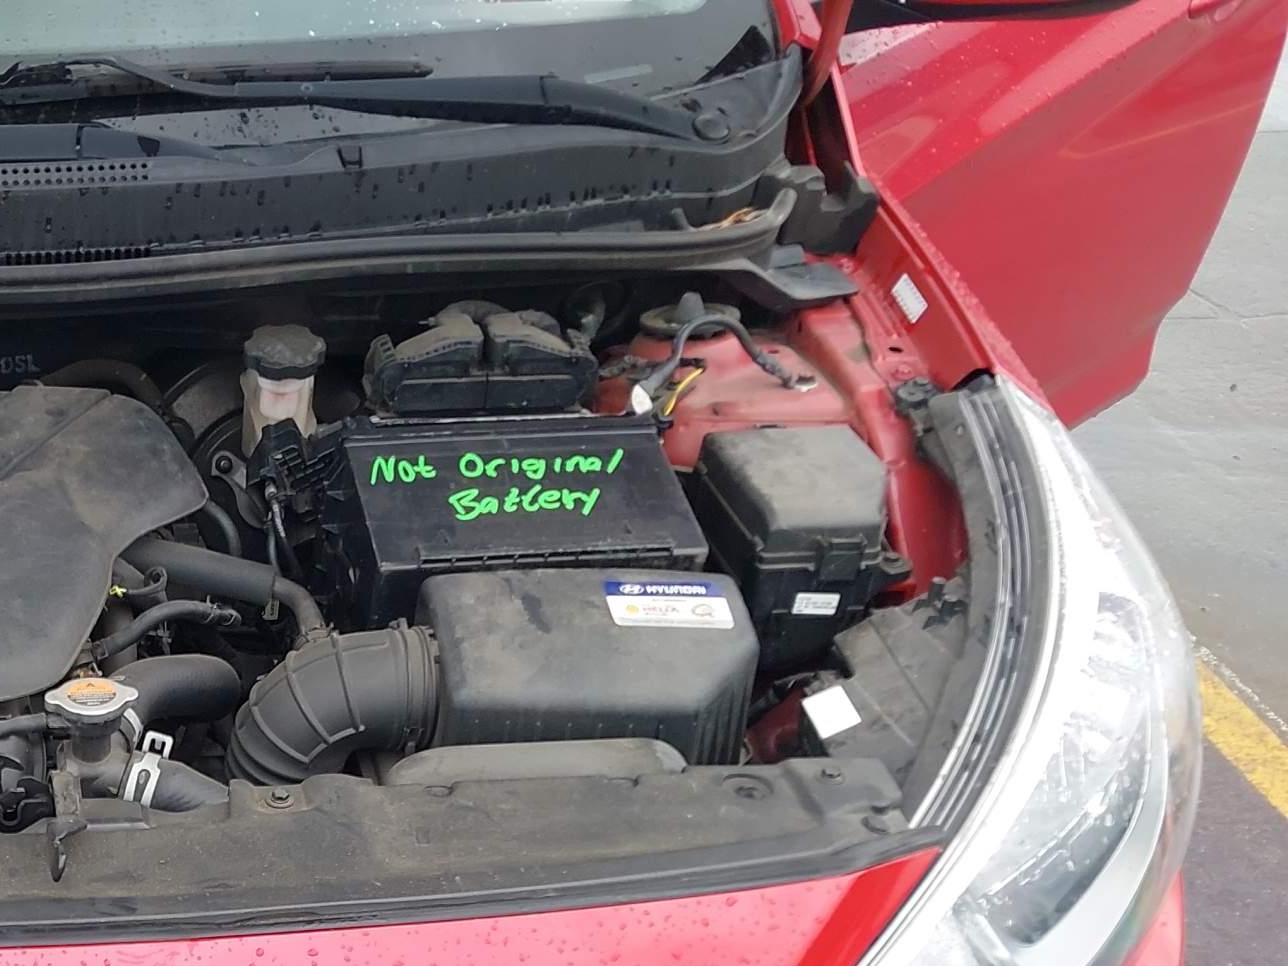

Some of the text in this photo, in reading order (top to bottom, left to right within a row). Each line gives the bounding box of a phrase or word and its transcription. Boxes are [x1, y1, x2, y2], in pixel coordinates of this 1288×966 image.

[369, 447, 625, 486] Not Original
[448, 484, 602, 521] Battery
